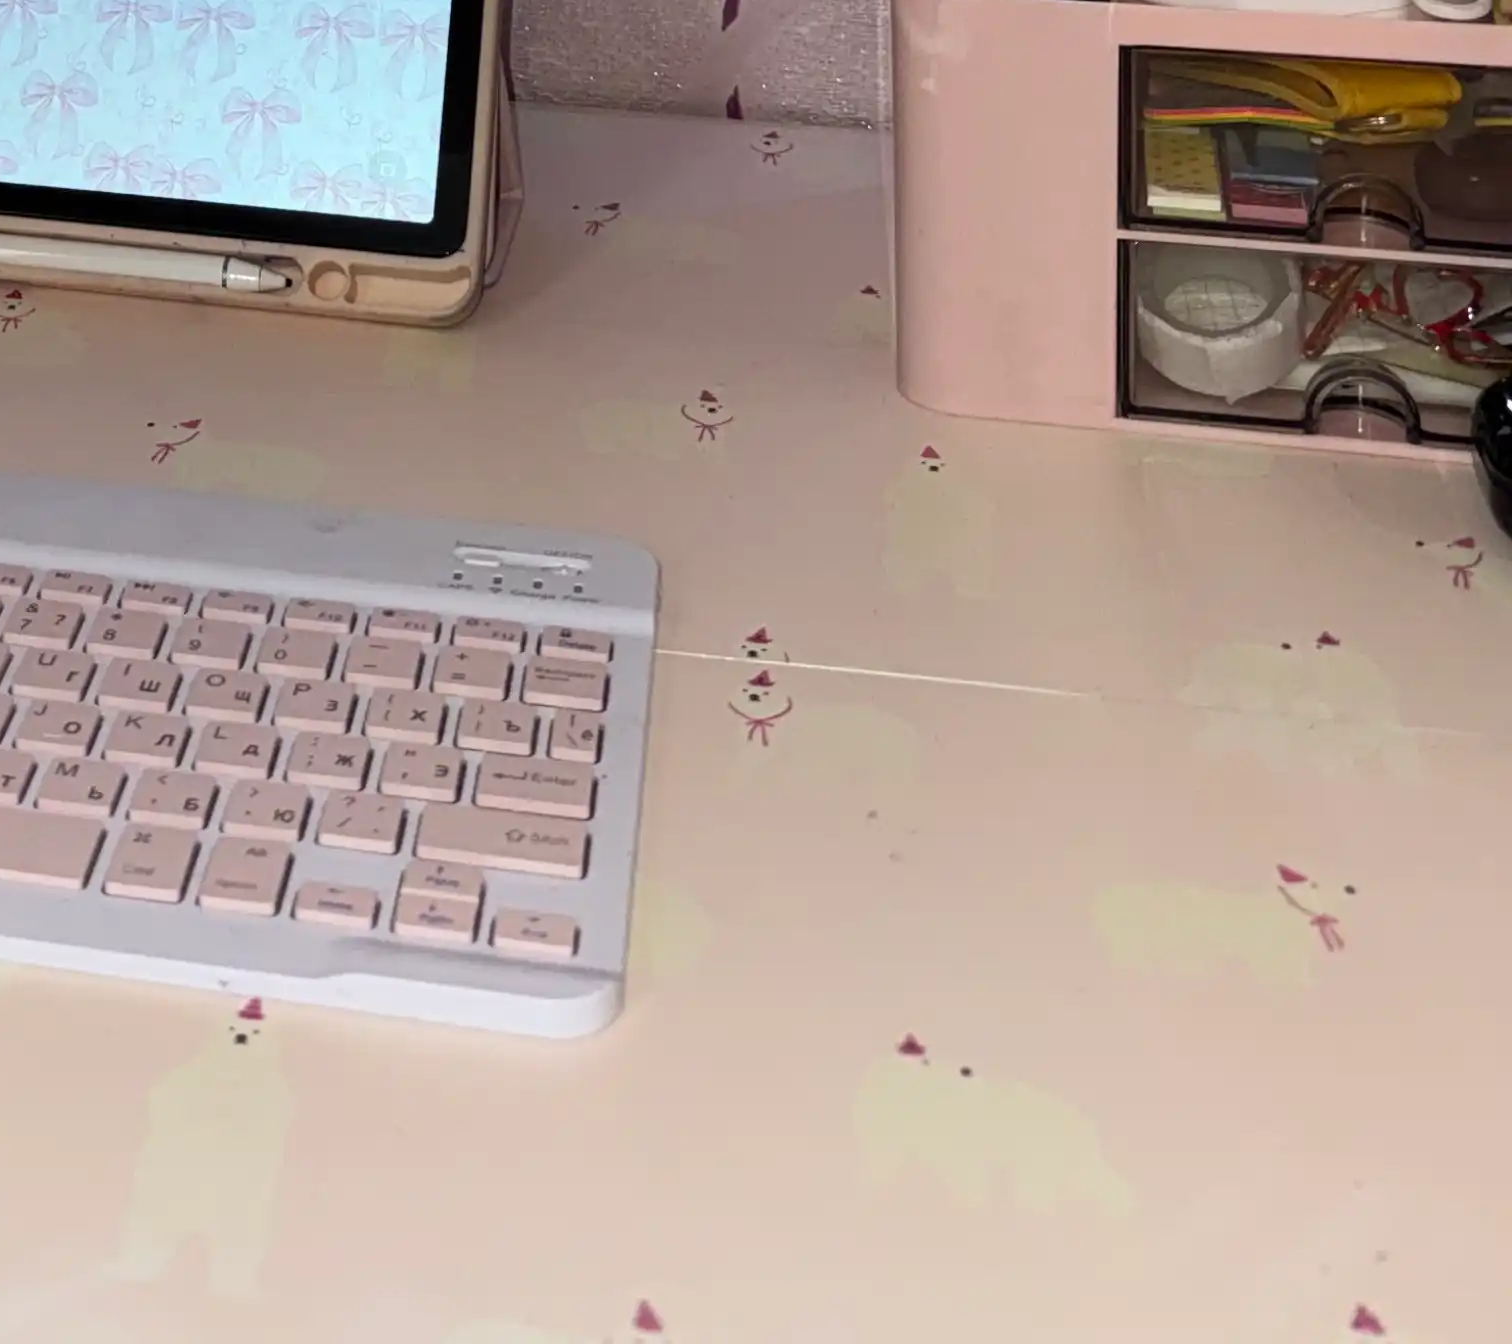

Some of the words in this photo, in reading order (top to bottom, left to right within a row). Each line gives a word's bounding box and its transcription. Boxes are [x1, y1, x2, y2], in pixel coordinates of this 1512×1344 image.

[19, 618, 33, 631] 7
[102, 628, 117, 641] 8
[188, 639, 202, 651] 9
[37, 652, 58, 667] U
[273, 648, 288, 660] 0
[123, 663, 133, 676] I
[65, 671, 81, 683] Г
[206, 673, 226, 687] O
[139, 679, 162, 693] Ш
[292, 682, 312, 696] P
[33, 703, 48, 716] J
[324, 699, 339, 712] З
[62, 721, 82, 734] О
[124, 715, 145, 730] K
[213, 725, 229, 739] L
[153, 733, 176, 747] Л
[242, 744, 260, 757] Д
[334, 753, 356, 768] Ж
[55, 761, 81, 777] M
[434, 764, 450, 778] Э
[530, 771, 577, 787] Enter
[88, 786, 105, 800] Ь
[182, 797, 200, 812] Б
[273, 808, 296, 823] Ю
